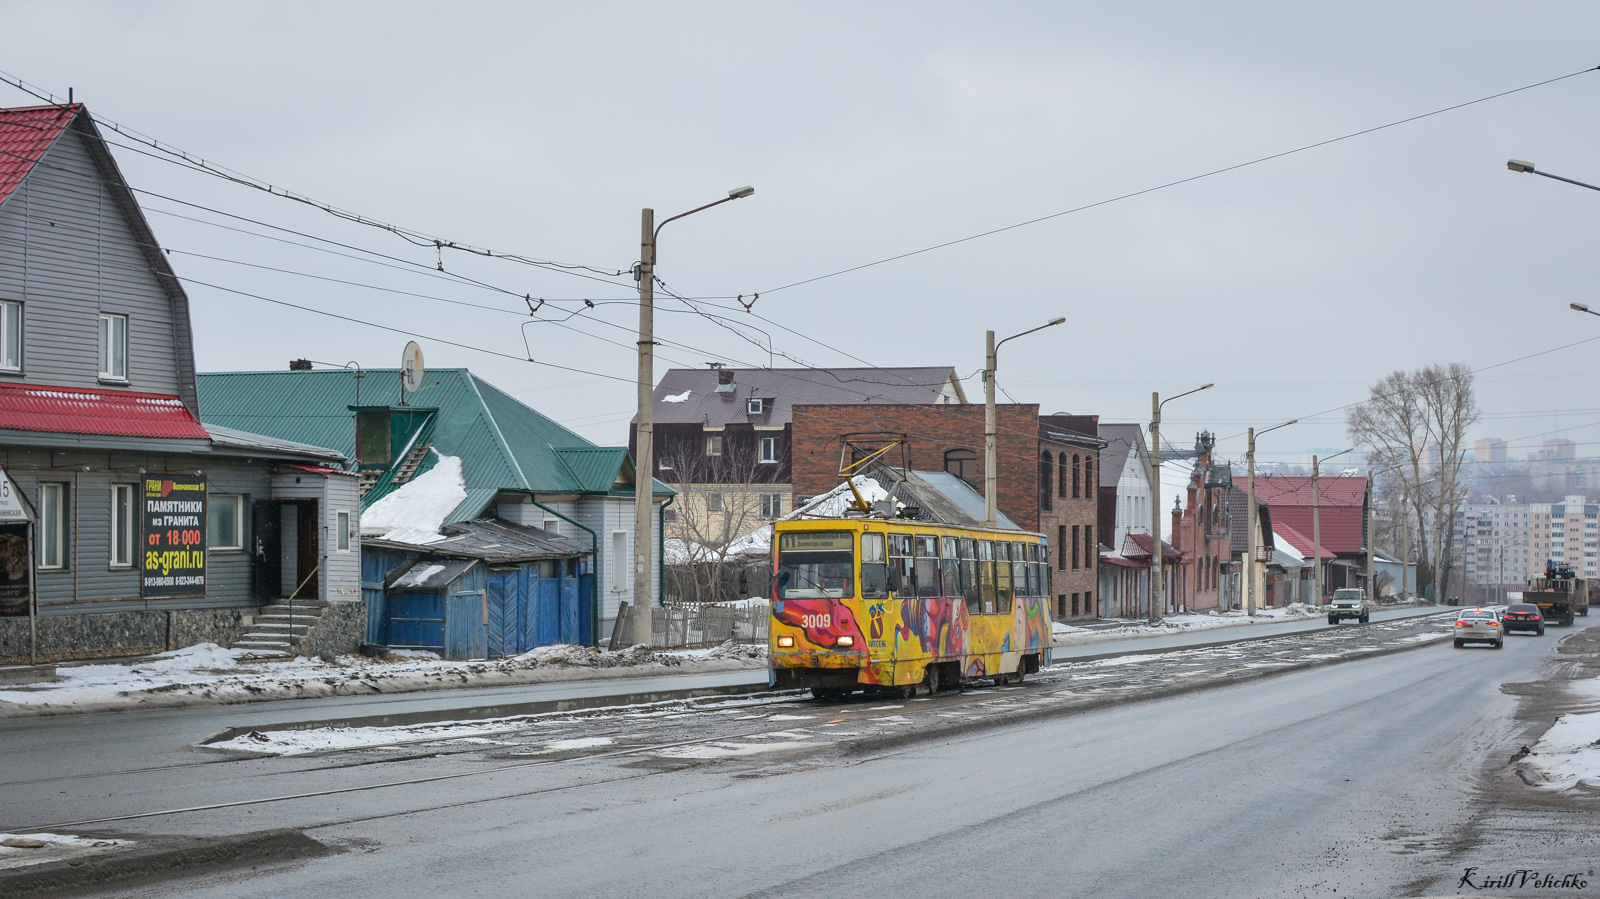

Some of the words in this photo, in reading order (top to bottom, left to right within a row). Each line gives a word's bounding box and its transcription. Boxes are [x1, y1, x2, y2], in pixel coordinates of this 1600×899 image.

[146, 480, 161, 491] ГРАНИ
[147, 500, 203, 513] ПАМЯТНИКИ
[152, 518, 162, 526] из
[164, 515, 199, 526] ГРАНИТА
[148, 534, 161, 545] от
[167, 530, 179, 545] 18
[182, 530, 201, 545] 000
[783, 534, 796, 548] 11
[146, 545, 203, 576] as-grani.ru
[801, 613, 831, 629] 3009
